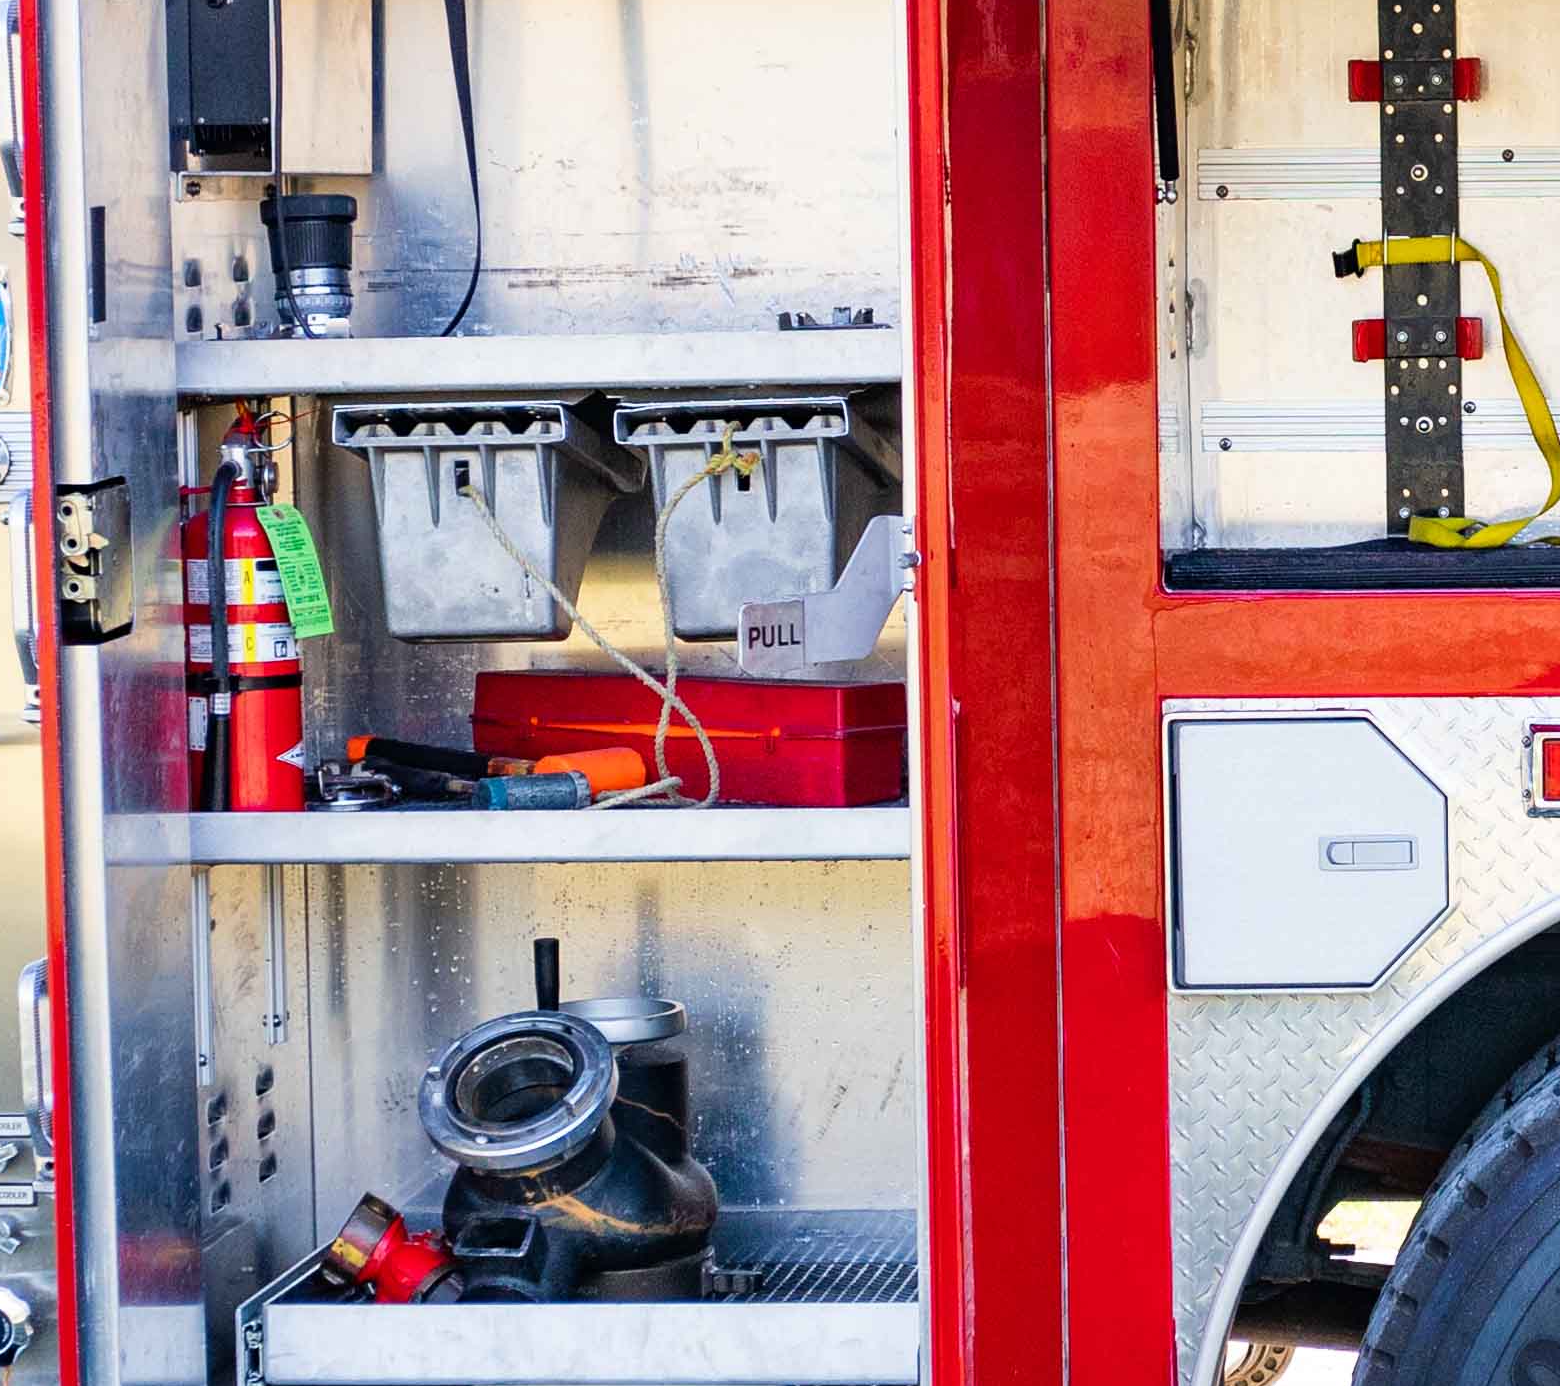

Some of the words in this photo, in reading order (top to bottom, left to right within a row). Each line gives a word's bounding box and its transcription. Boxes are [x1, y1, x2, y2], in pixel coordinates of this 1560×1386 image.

[243, 571, 251, 584] A
[747, 624, 801, 648] PULL
[246, 637, 253, 650] C
